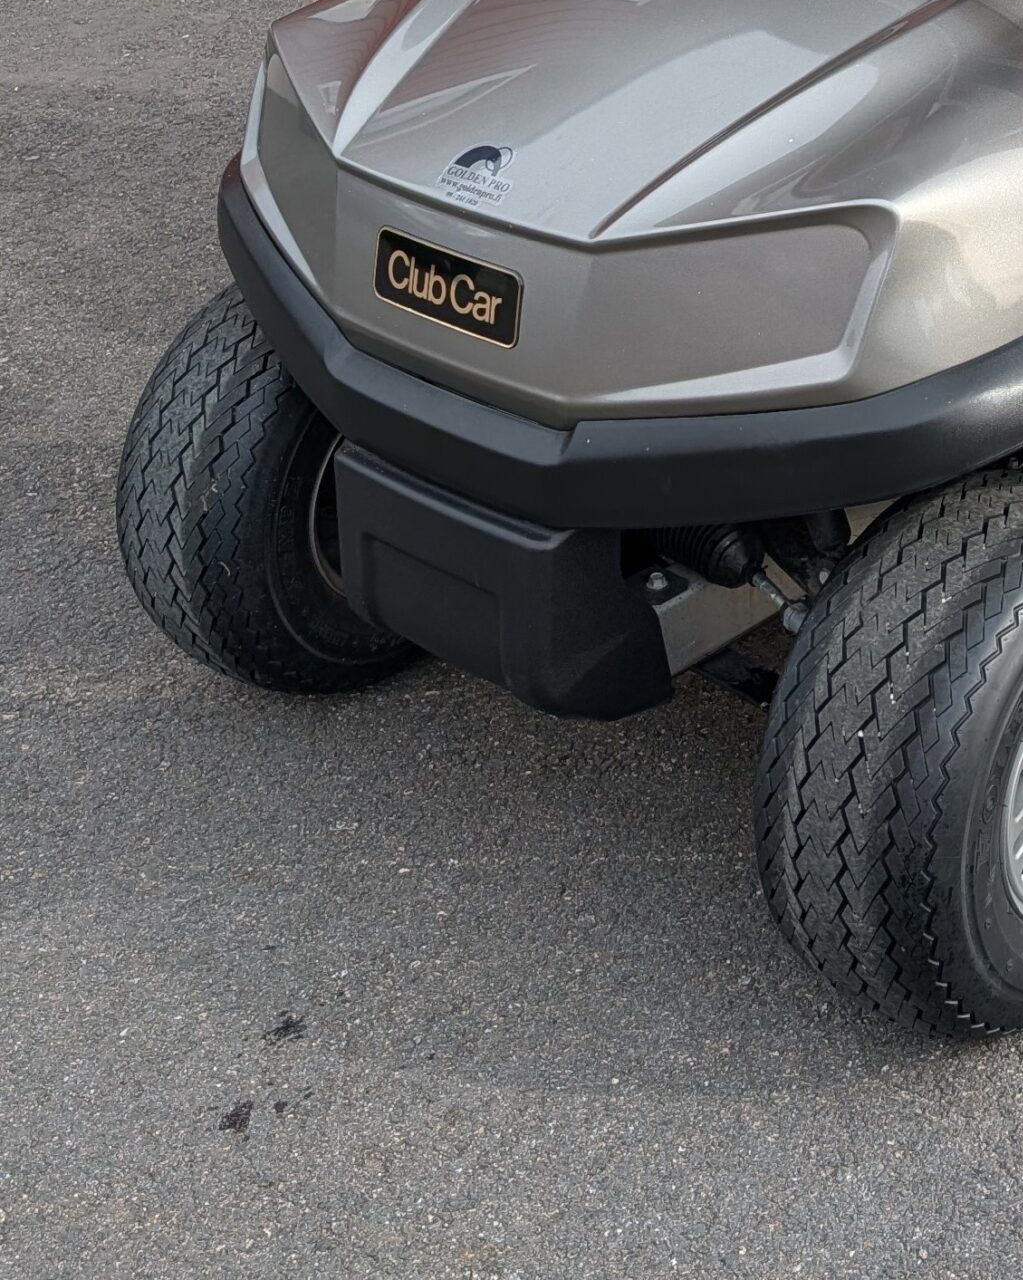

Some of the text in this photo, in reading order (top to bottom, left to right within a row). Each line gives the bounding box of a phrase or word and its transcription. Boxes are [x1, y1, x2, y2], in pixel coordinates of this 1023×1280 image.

[440, 176, 503, 203] www.goldenpro.fi
[447, 166, 511, 193] GOLDEN PRO
[387, 249, 503, 325] Club Car
